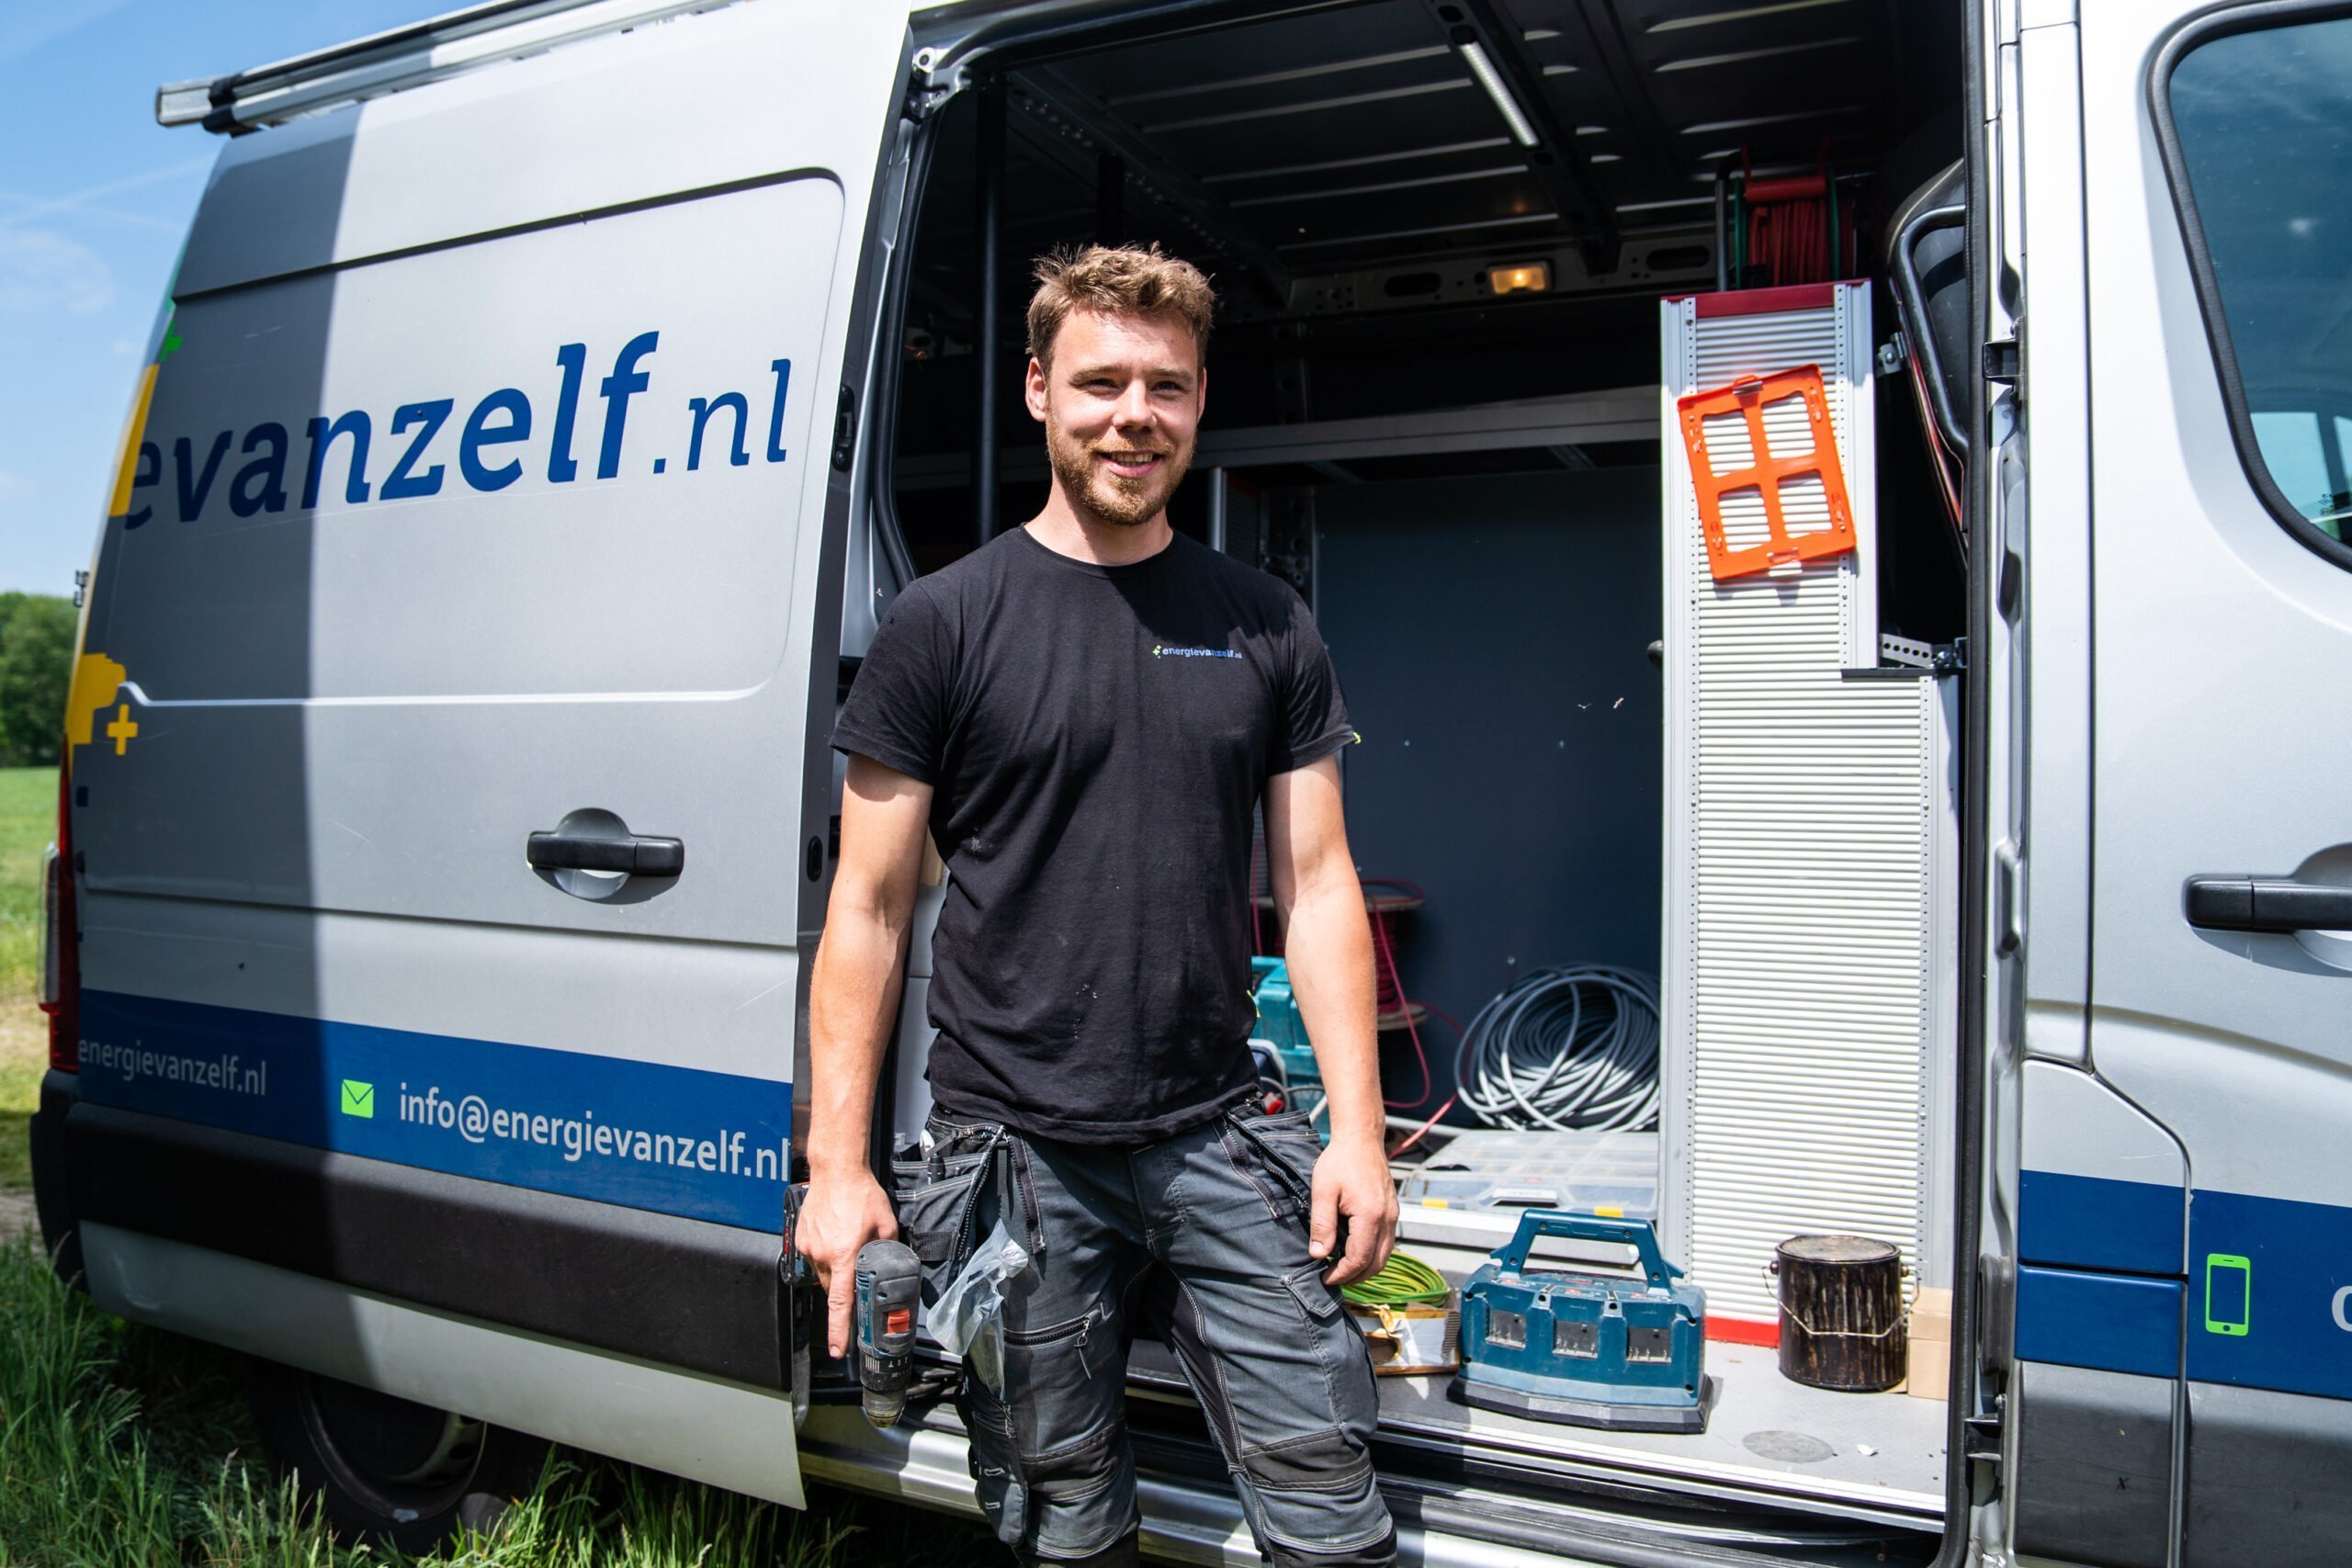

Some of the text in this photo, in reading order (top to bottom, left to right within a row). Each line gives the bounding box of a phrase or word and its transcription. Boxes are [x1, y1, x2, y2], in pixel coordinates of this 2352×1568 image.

[125, 331, 791, 531] evanzelf.nl
[1162, 646, 1242, 660] energievanzelf.nl
[77, 1039, 266, 1096] energievanzelf.nl
[400, 1082, 788, 1182] info@energievanzelf.nl
